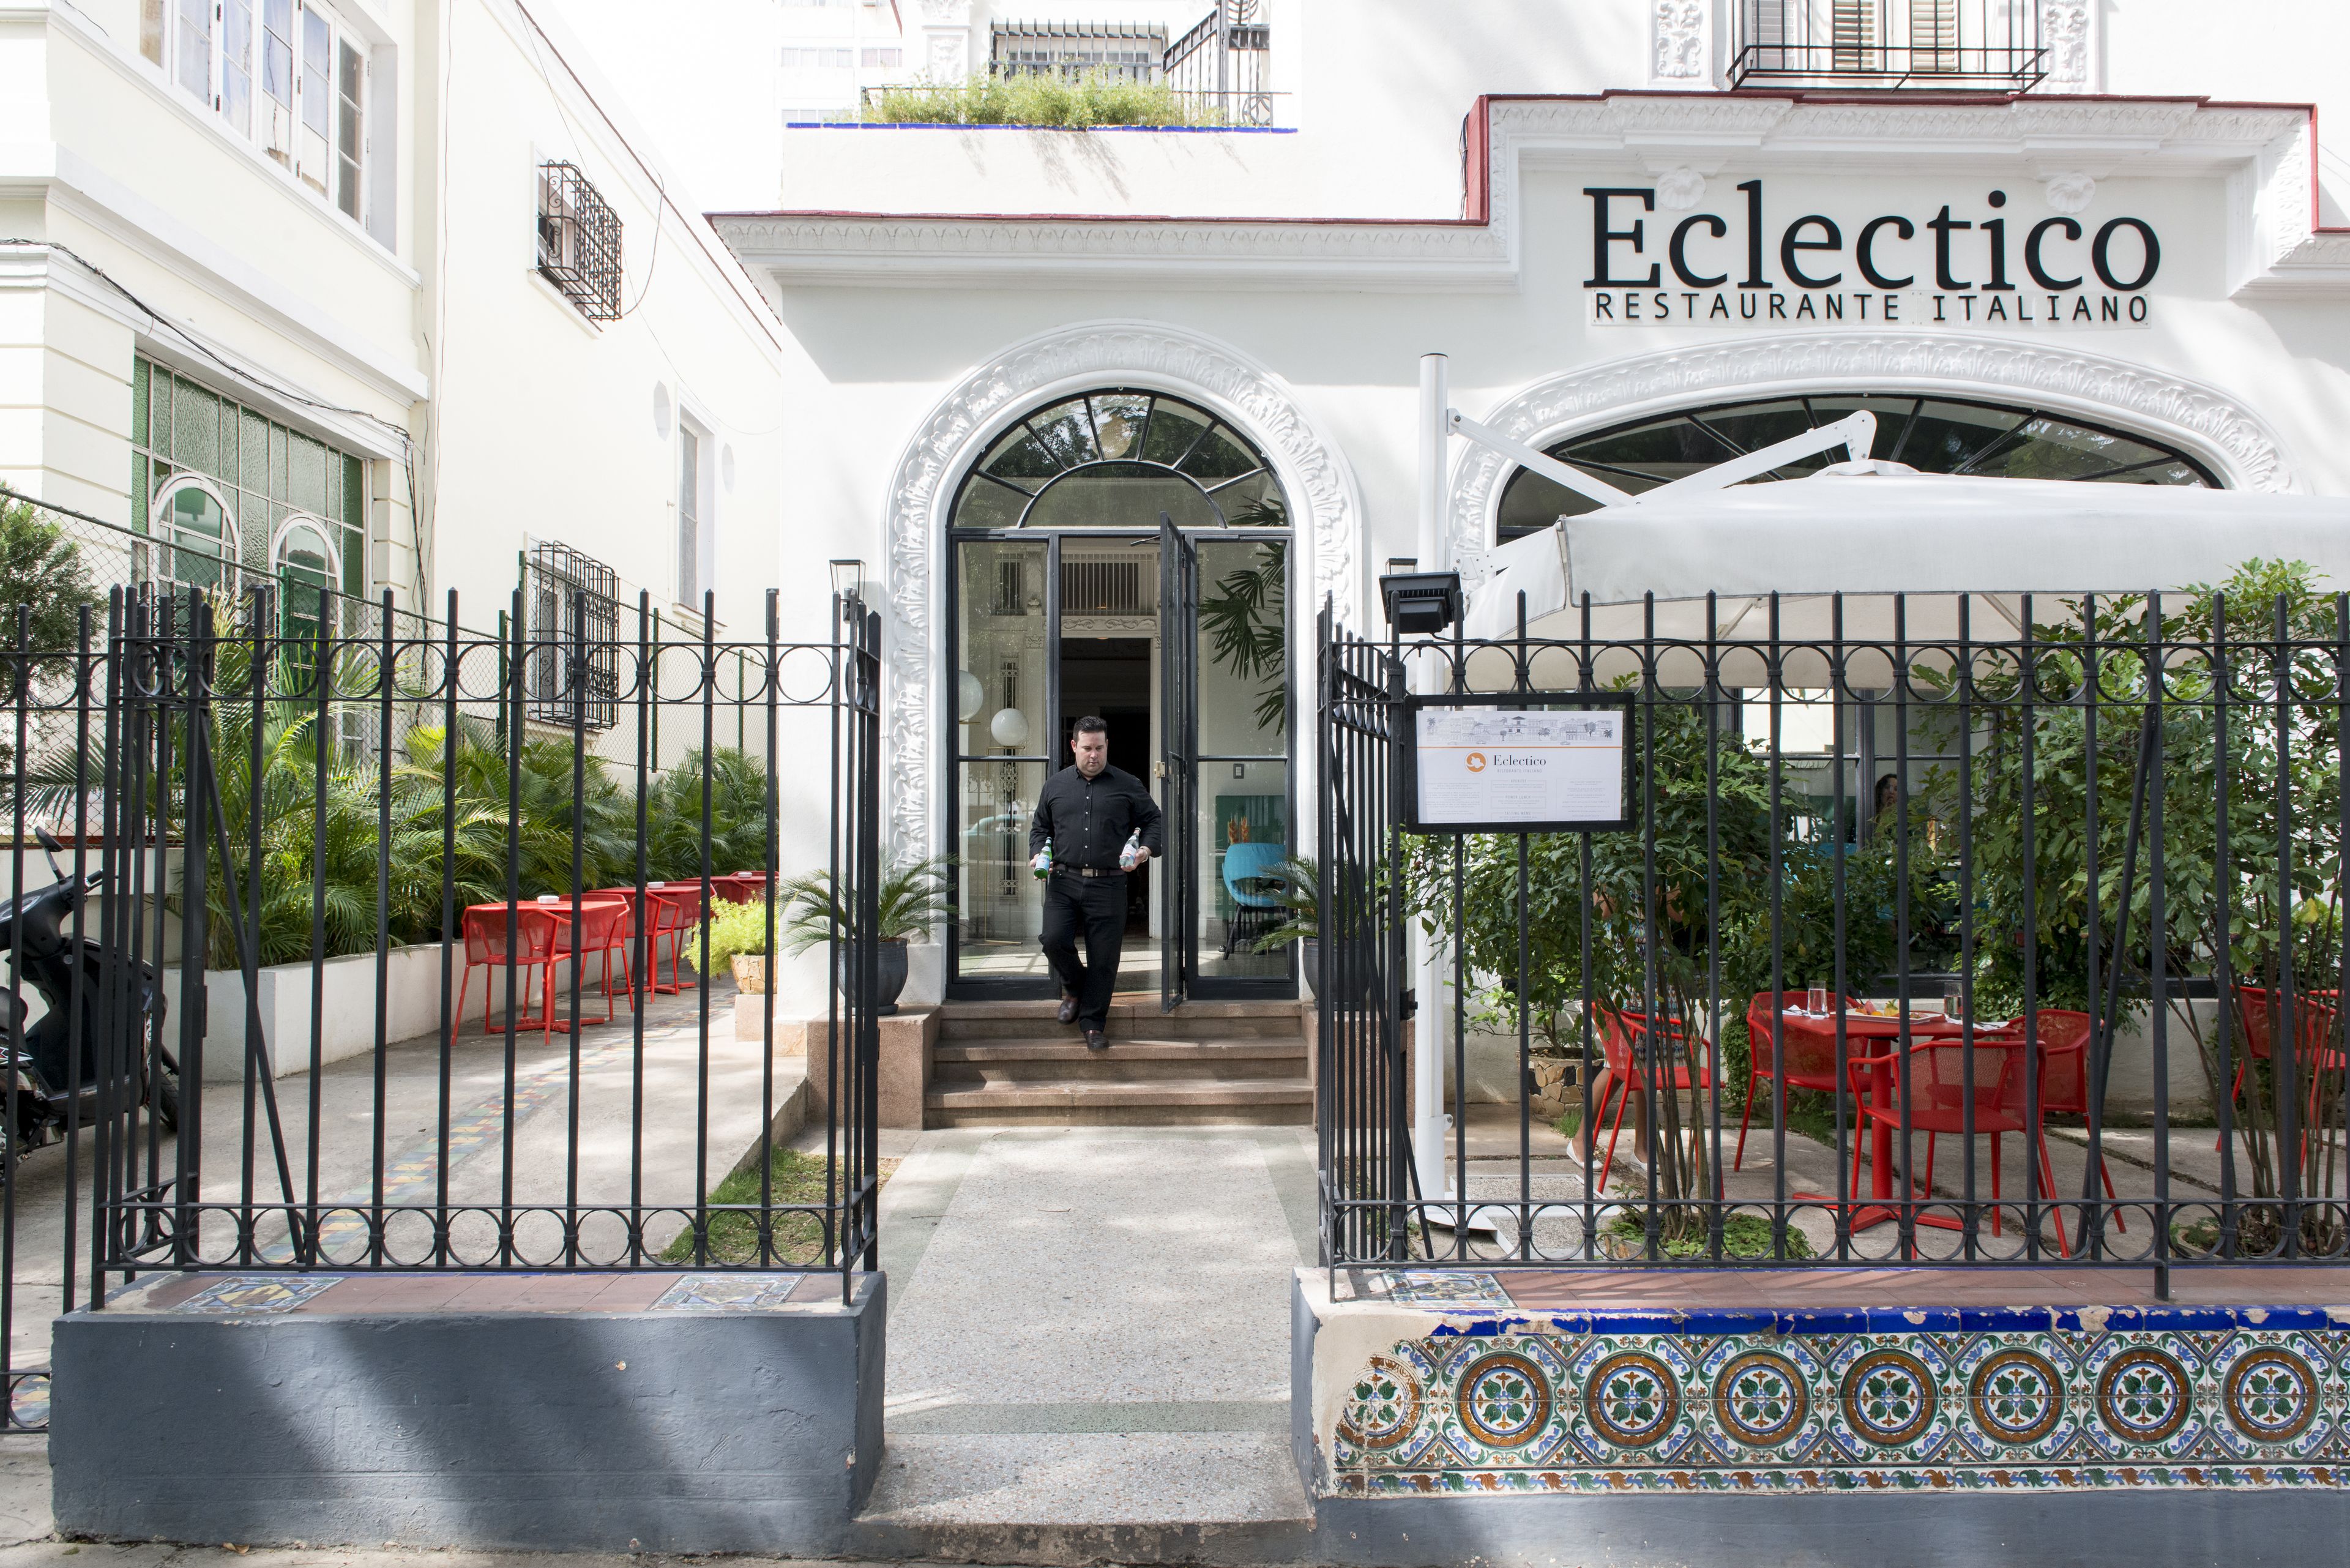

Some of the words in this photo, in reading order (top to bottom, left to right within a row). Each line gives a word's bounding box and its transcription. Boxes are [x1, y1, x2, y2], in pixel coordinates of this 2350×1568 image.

[1583, 179, 2160, 291] Eclectico
[1596, 293, 1898, 320] RESTAURANTE
[1933, 295, 2147, 322] ITALIANO
[1493, 755, 1546, 766] Eclectico
